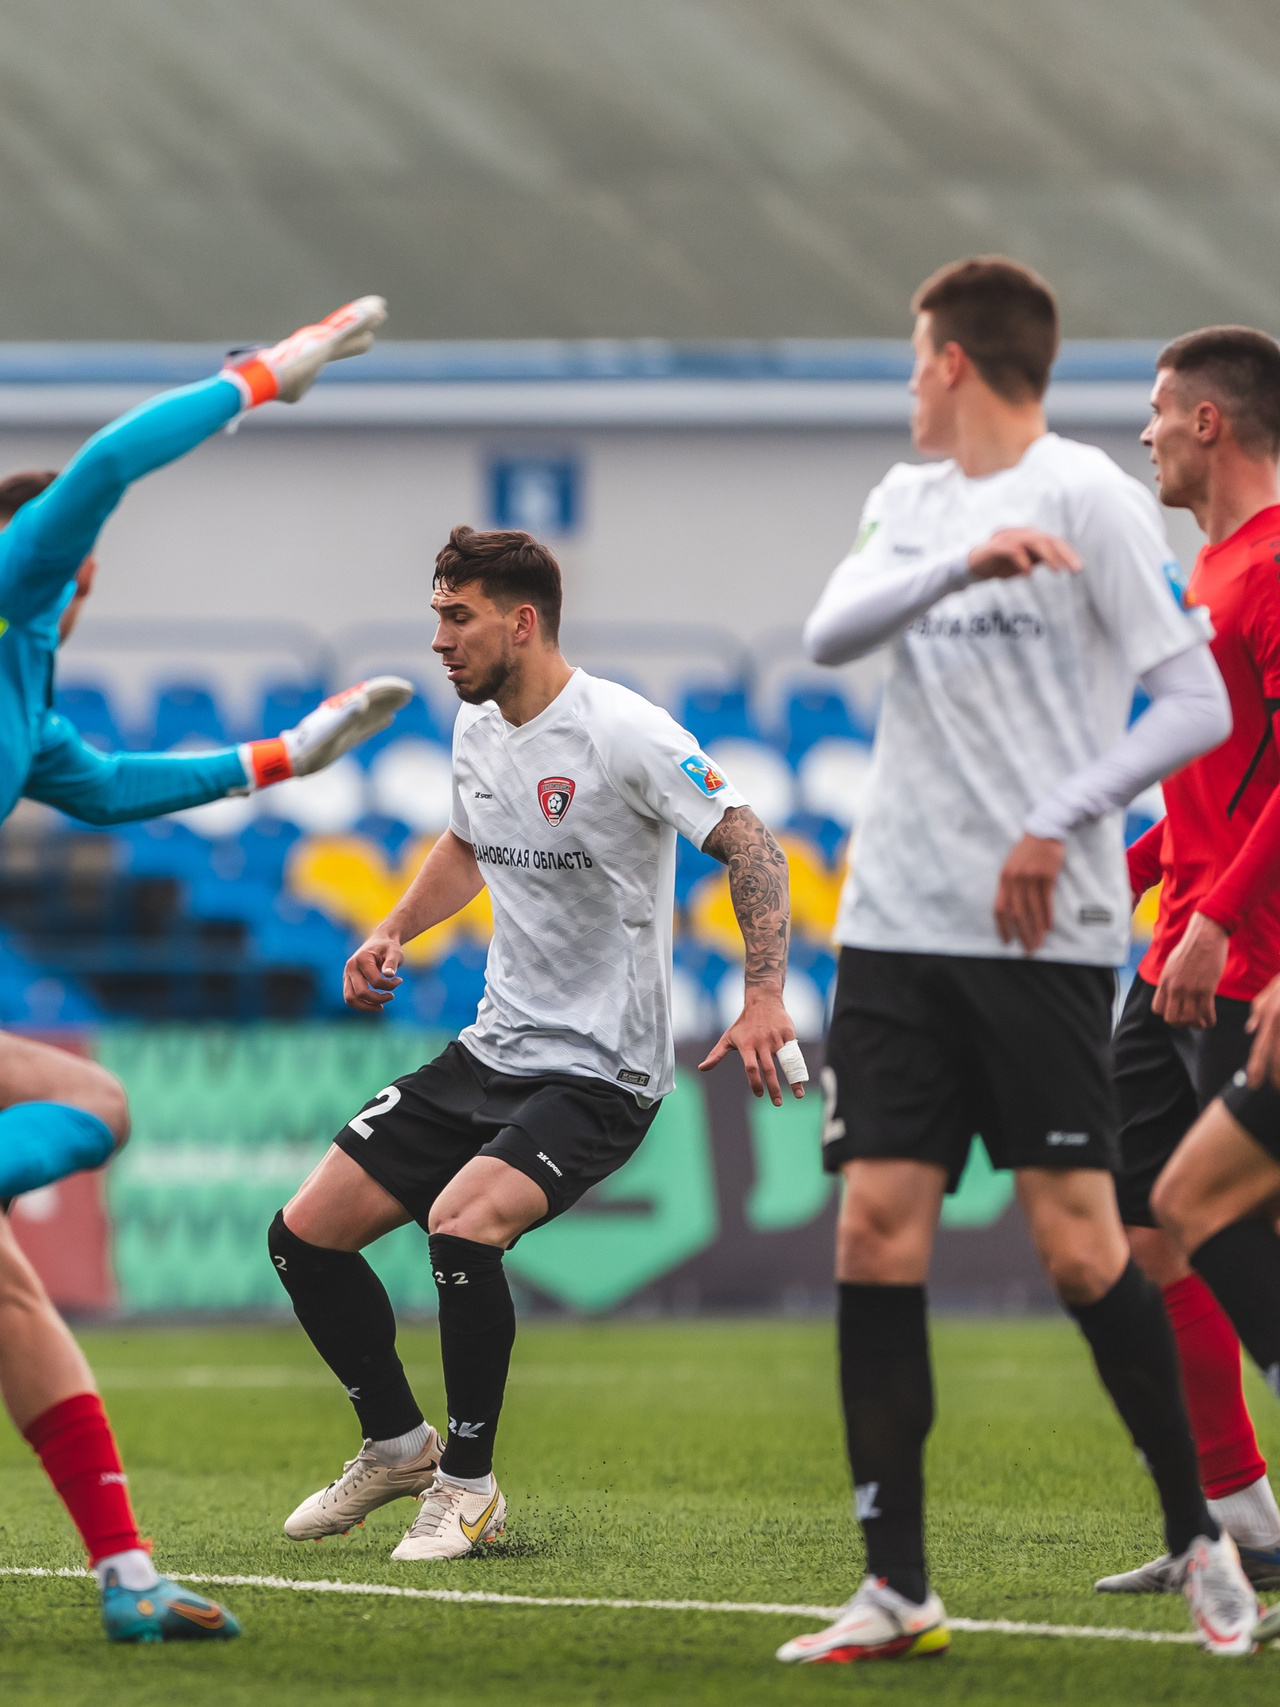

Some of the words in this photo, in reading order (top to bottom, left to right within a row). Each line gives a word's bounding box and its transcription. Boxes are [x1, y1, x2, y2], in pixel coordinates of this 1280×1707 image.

[533, 850, 594, 870] ОБЛАСТЬ
[347, 1085, 402, 1140] 2
[536, 1151, 550, 1163] 2K
[546, 1160, 563, 1177] SPORT
